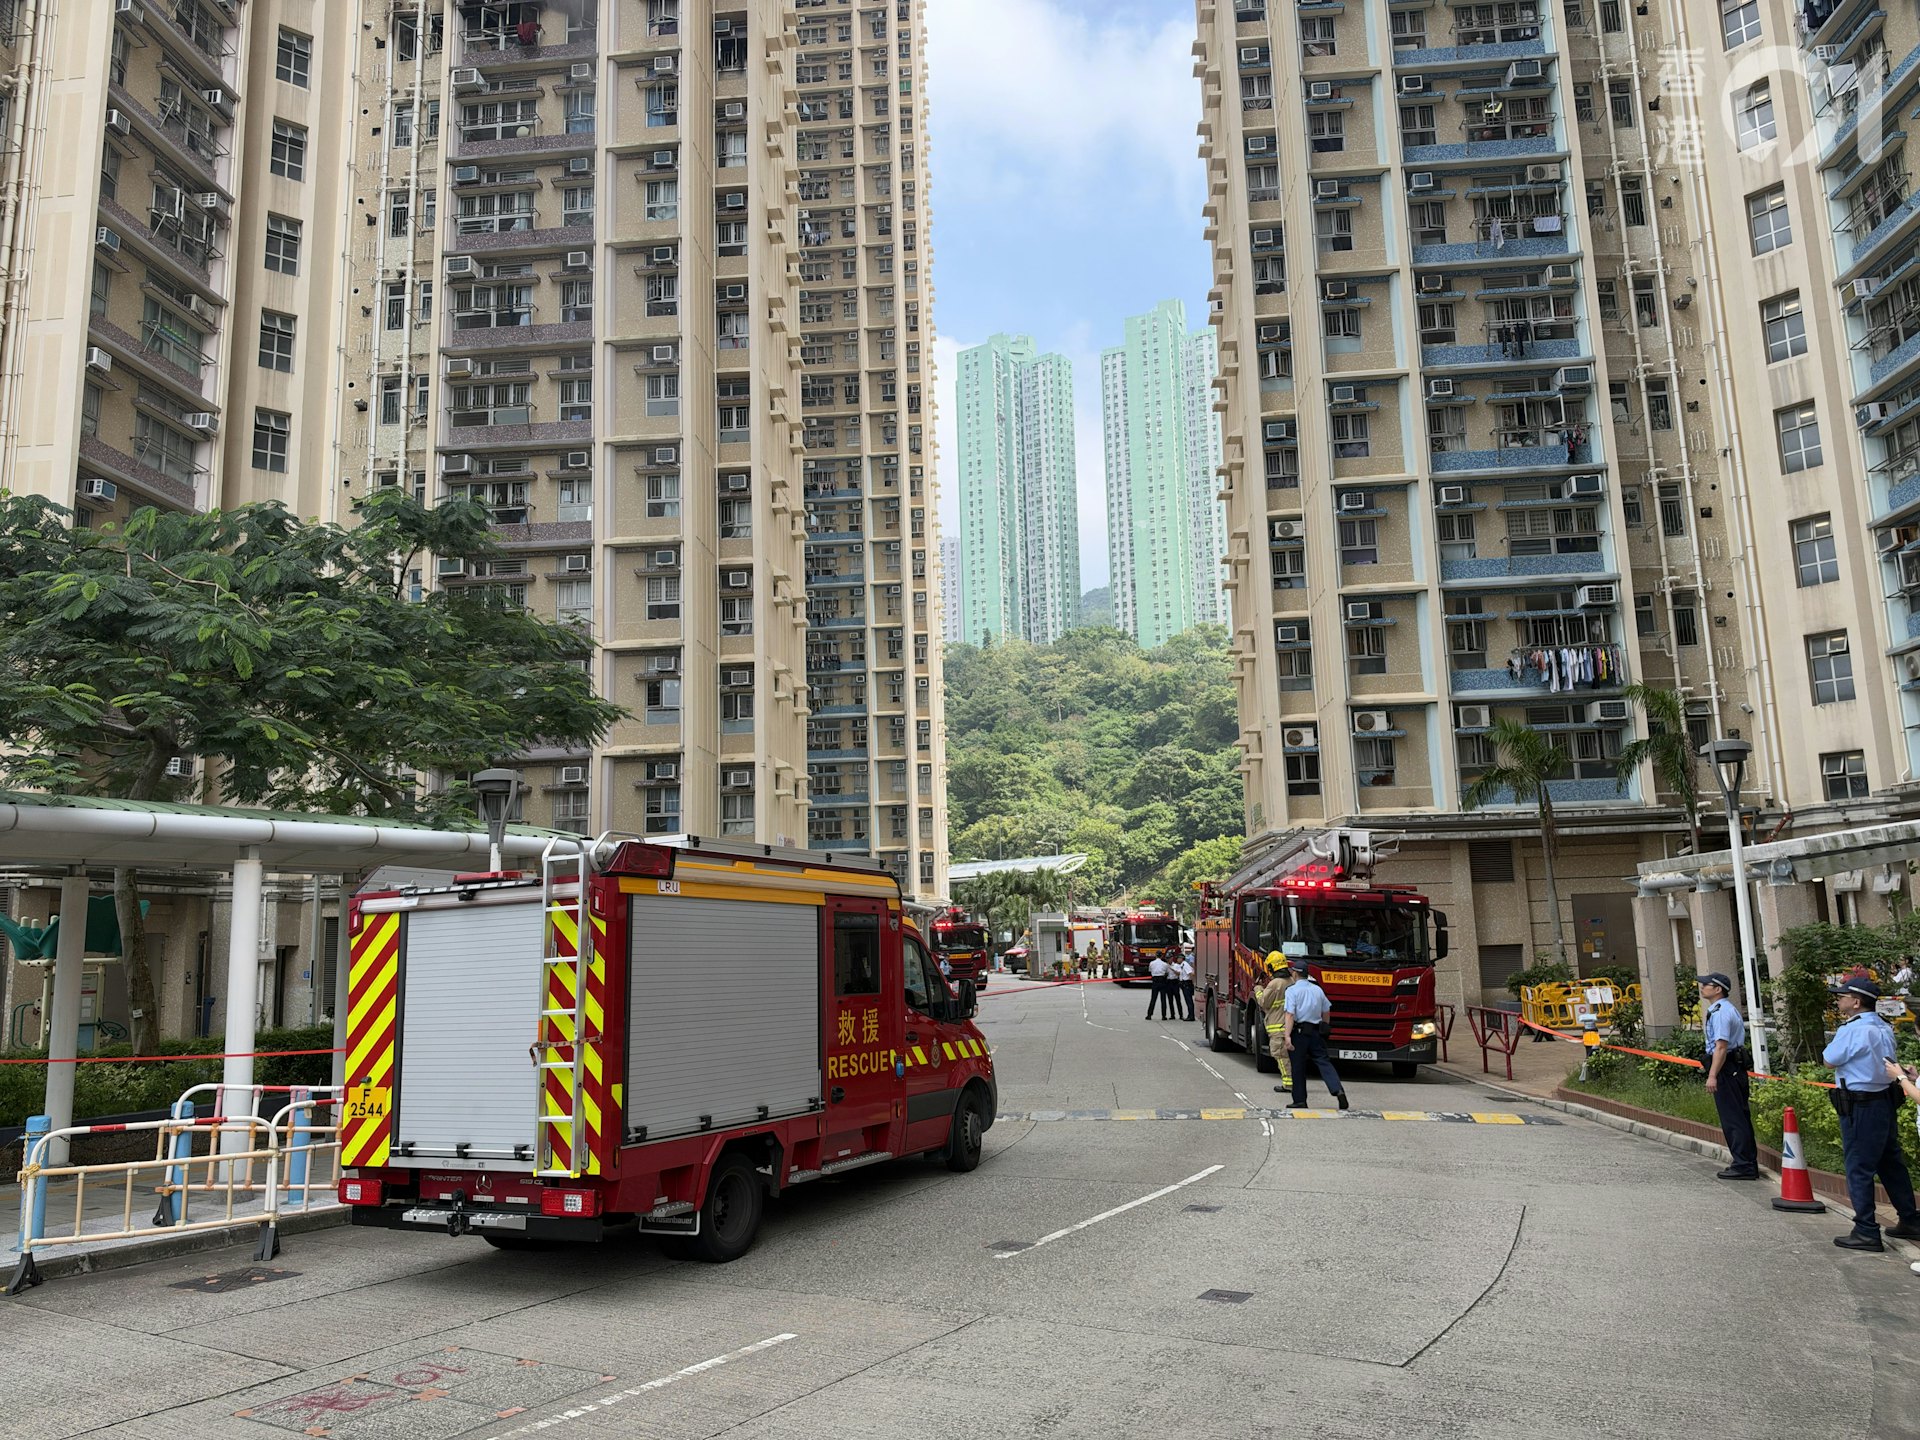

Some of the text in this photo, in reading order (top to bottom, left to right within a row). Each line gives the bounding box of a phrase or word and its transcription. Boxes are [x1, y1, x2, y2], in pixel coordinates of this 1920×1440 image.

[659, 881, 679, 893] LRU
[1333, 974, 1348, 982] FIRE
[1349, 974, 1380, 983] SERVICES
[838, 1008, 880, 1046] 救援
[1352, 1051, 1373, 1059] 2360
[828, 1050, 889, 1079] RESCUE
[363, 1089, 371, 1102] F
[350, 1102, 383, 1117] 2544
